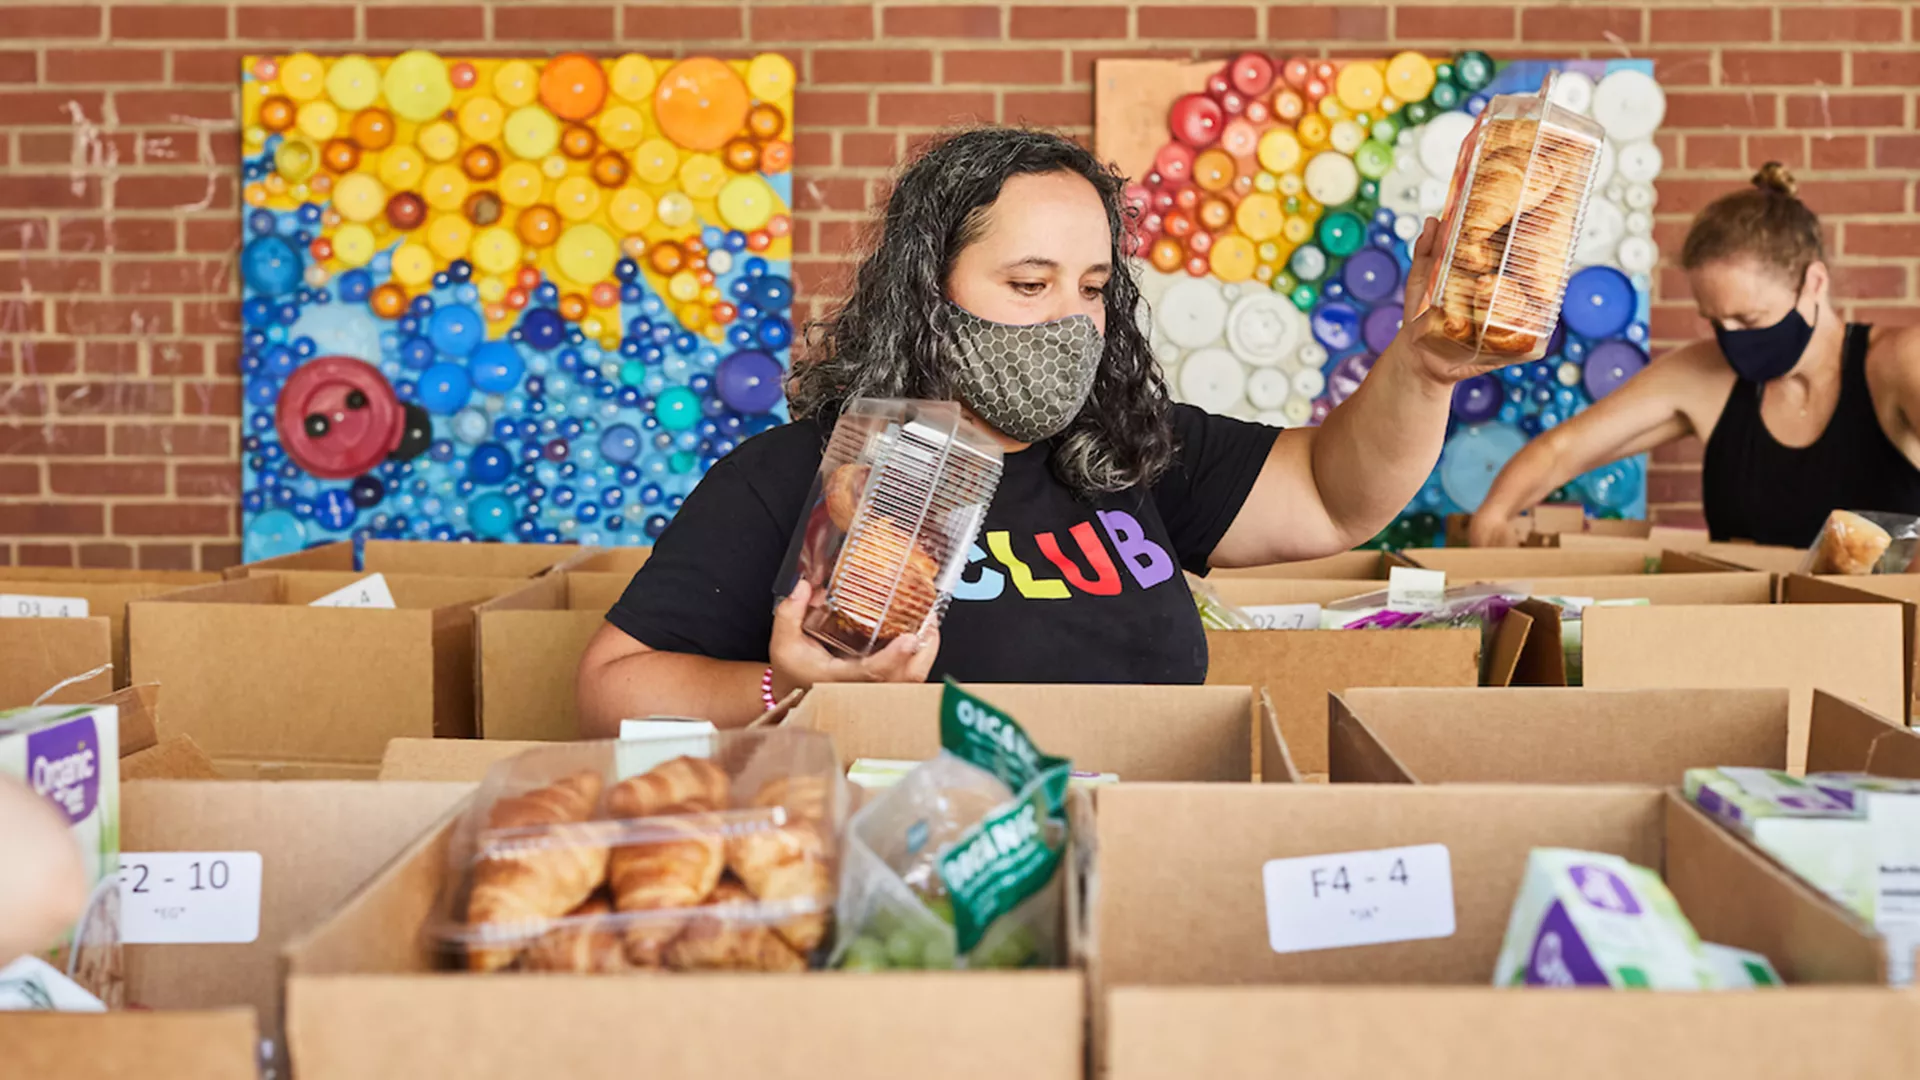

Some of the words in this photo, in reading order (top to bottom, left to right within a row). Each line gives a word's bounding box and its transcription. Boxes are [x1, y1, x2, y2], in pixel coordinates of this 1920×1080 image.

[952, 510, 1174, 600] CLUB
[189, 860, 230, 891] 10
[1311, 866, 1351, 898] F4
[1389, 858, 1409, 886] 4
